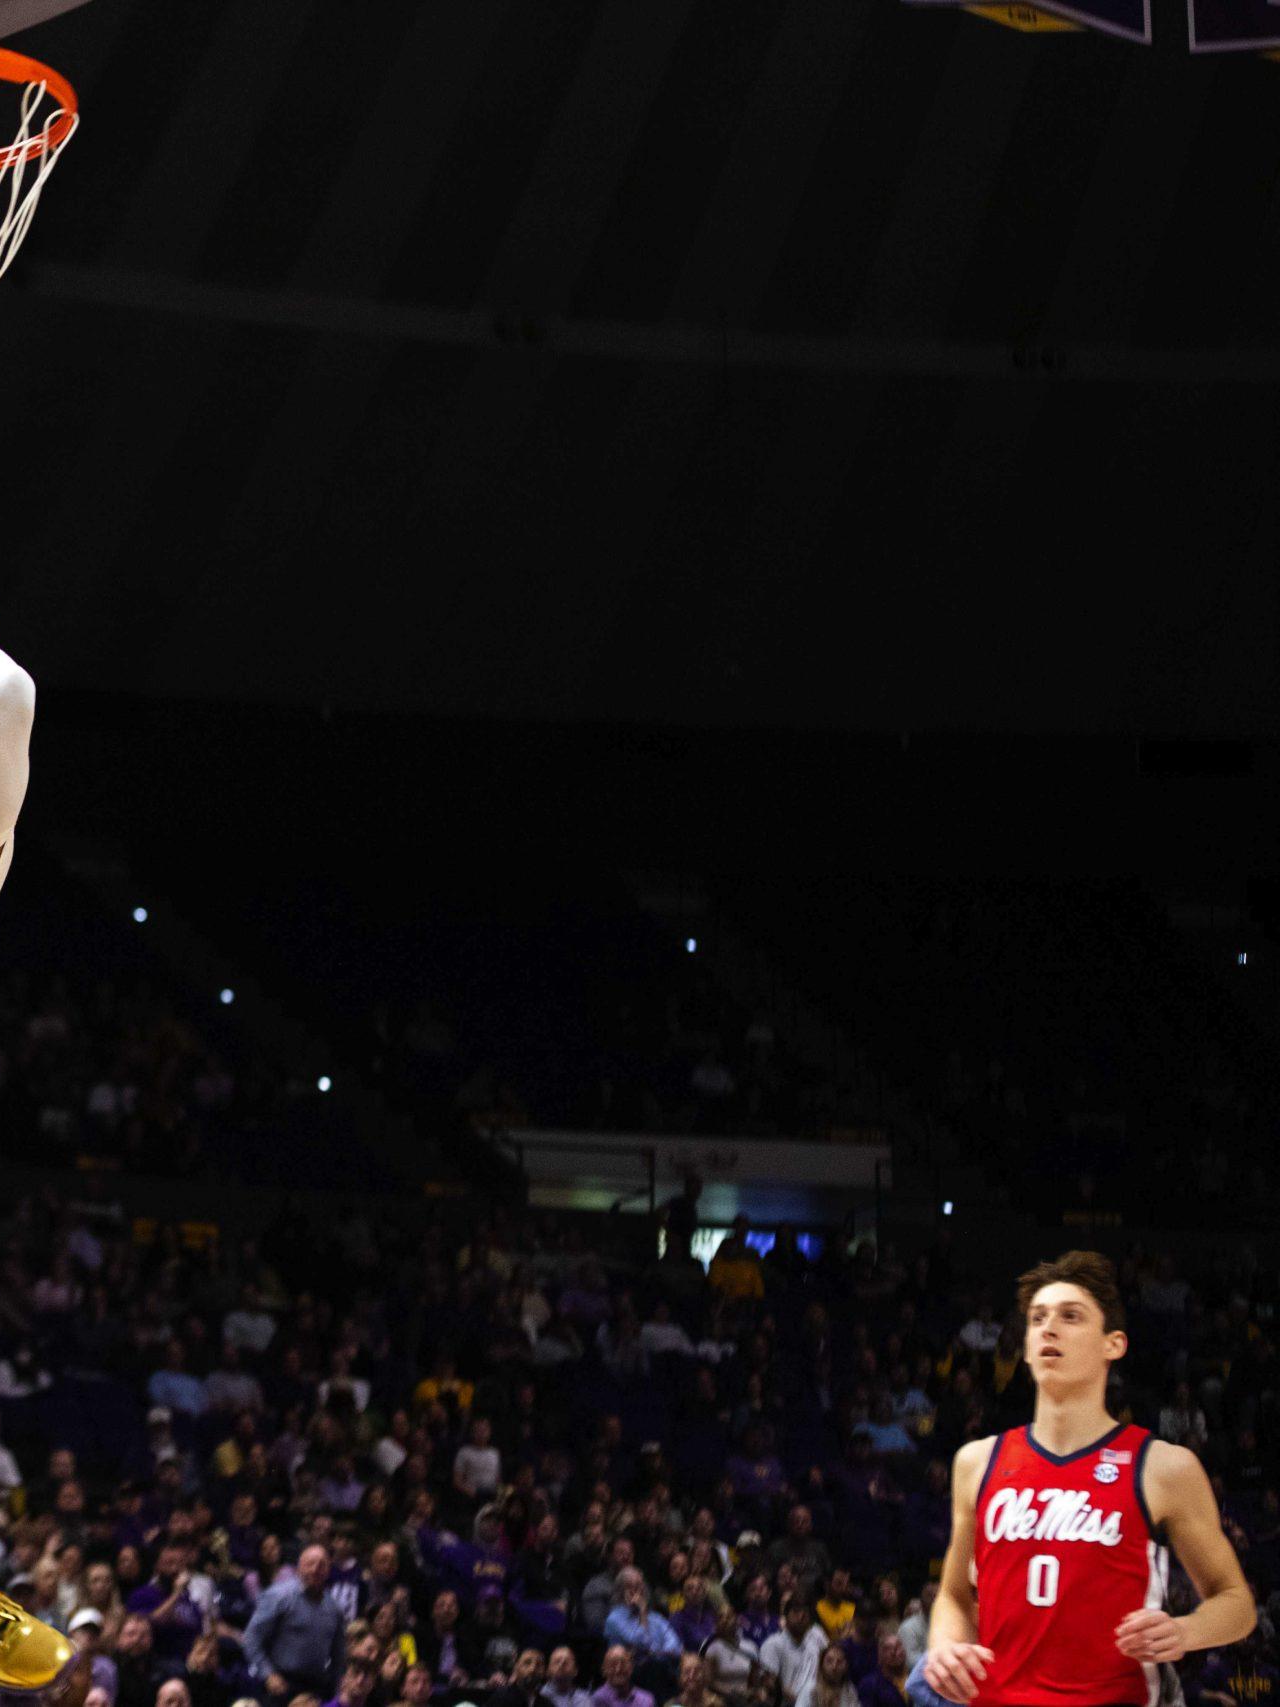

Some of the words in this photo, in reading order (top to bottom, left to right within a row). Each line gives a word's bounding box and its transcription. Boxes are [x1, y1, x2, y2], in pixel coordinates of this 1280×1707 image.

[985, 1488, 1036, 1543] Ole
[1037, 1489, 1123, 1546] Miss
[1026, 1554, 1060, 1607] 0
